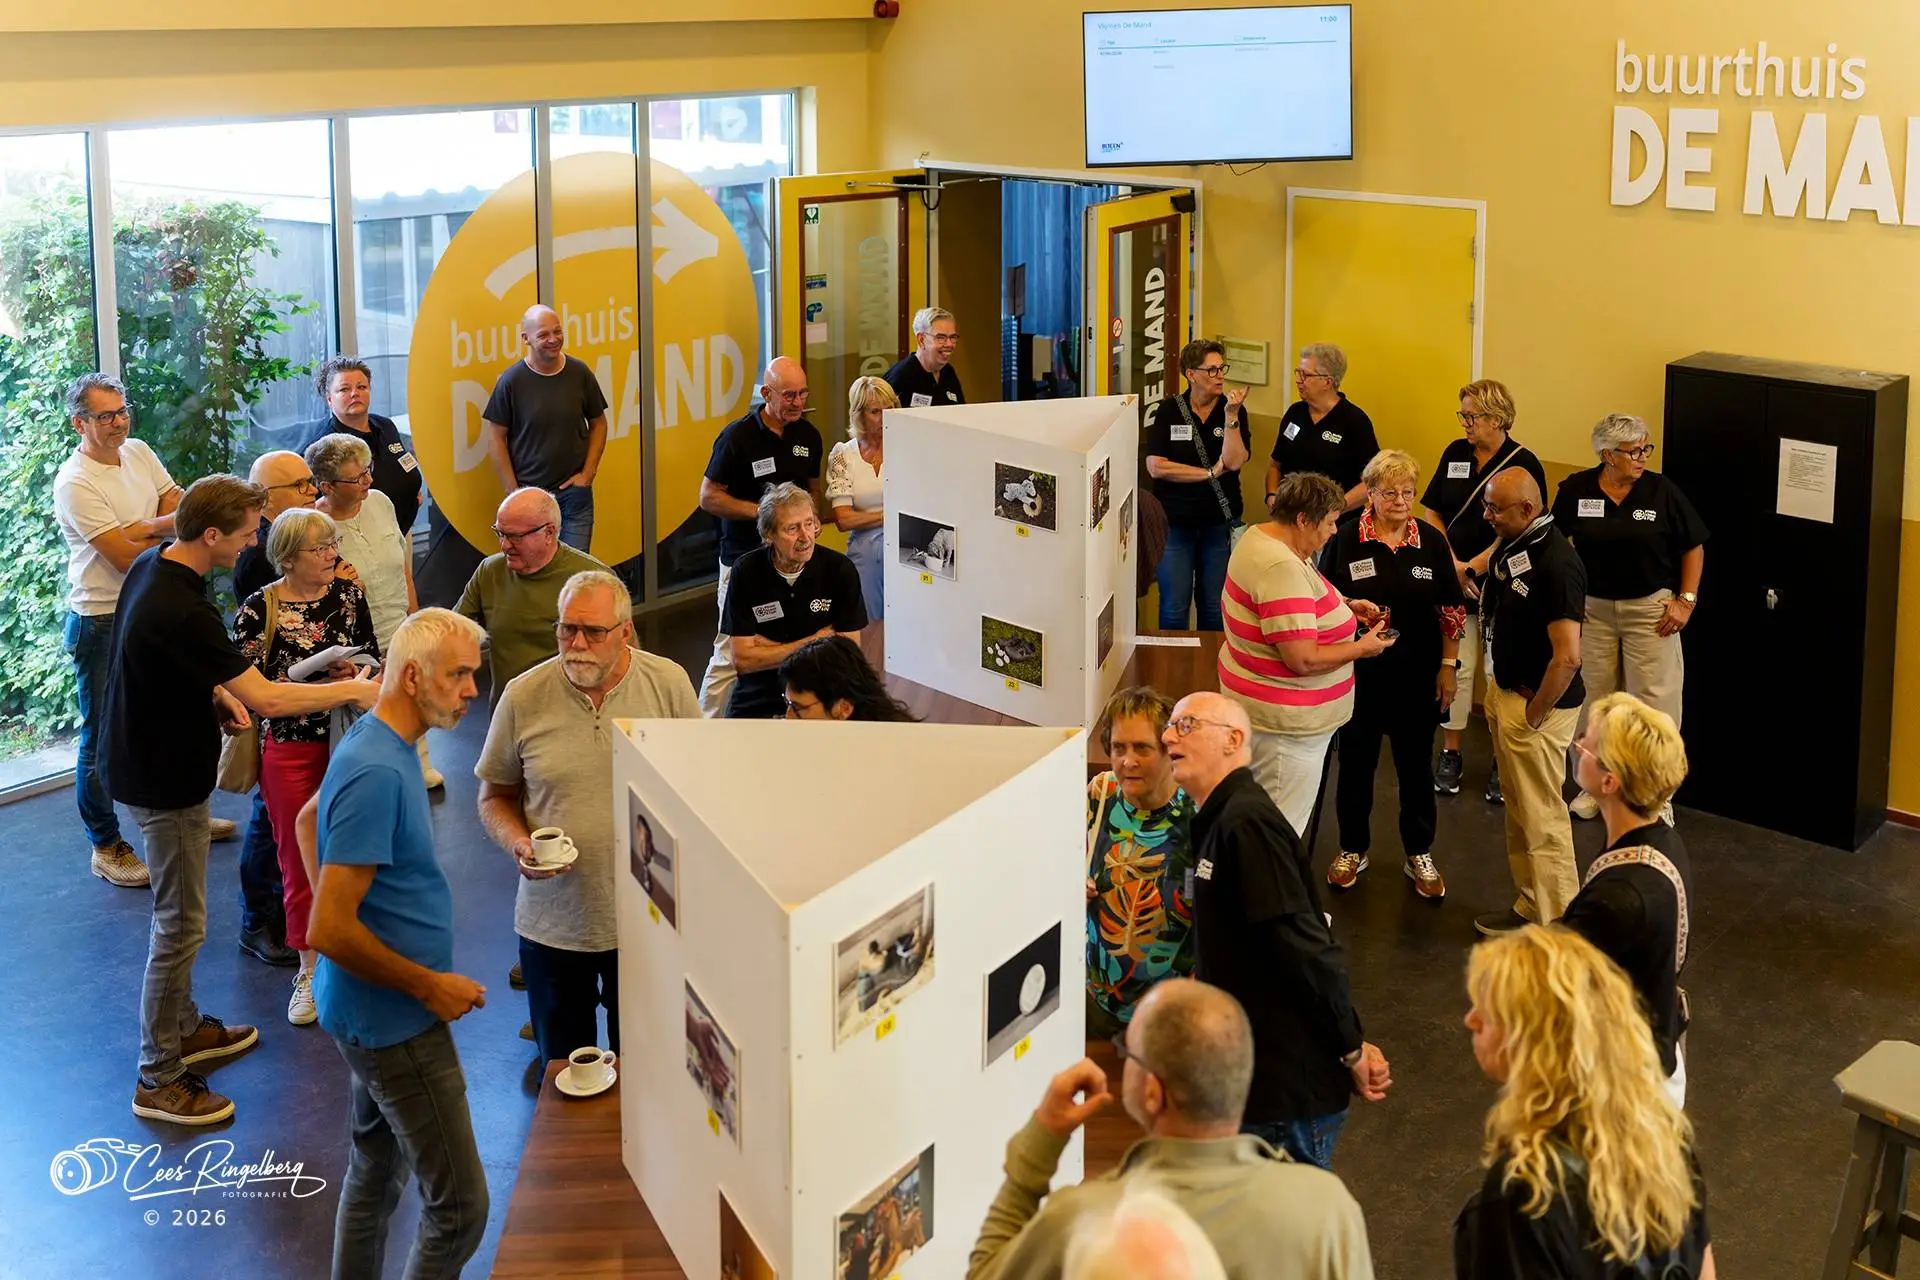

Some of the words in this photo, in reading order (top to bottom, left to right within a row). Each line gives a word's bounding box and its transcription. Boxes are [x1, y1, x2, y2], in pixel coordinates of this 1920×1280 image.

[1319, 15, 1337, 23] 11:00
[1615, 38, 1866, 100] buurthuis
[1610, 105, 1719, 211] DE
[451, 296, 635, 368] buuhuis
[1144, 267, 1165, 374] MAND
